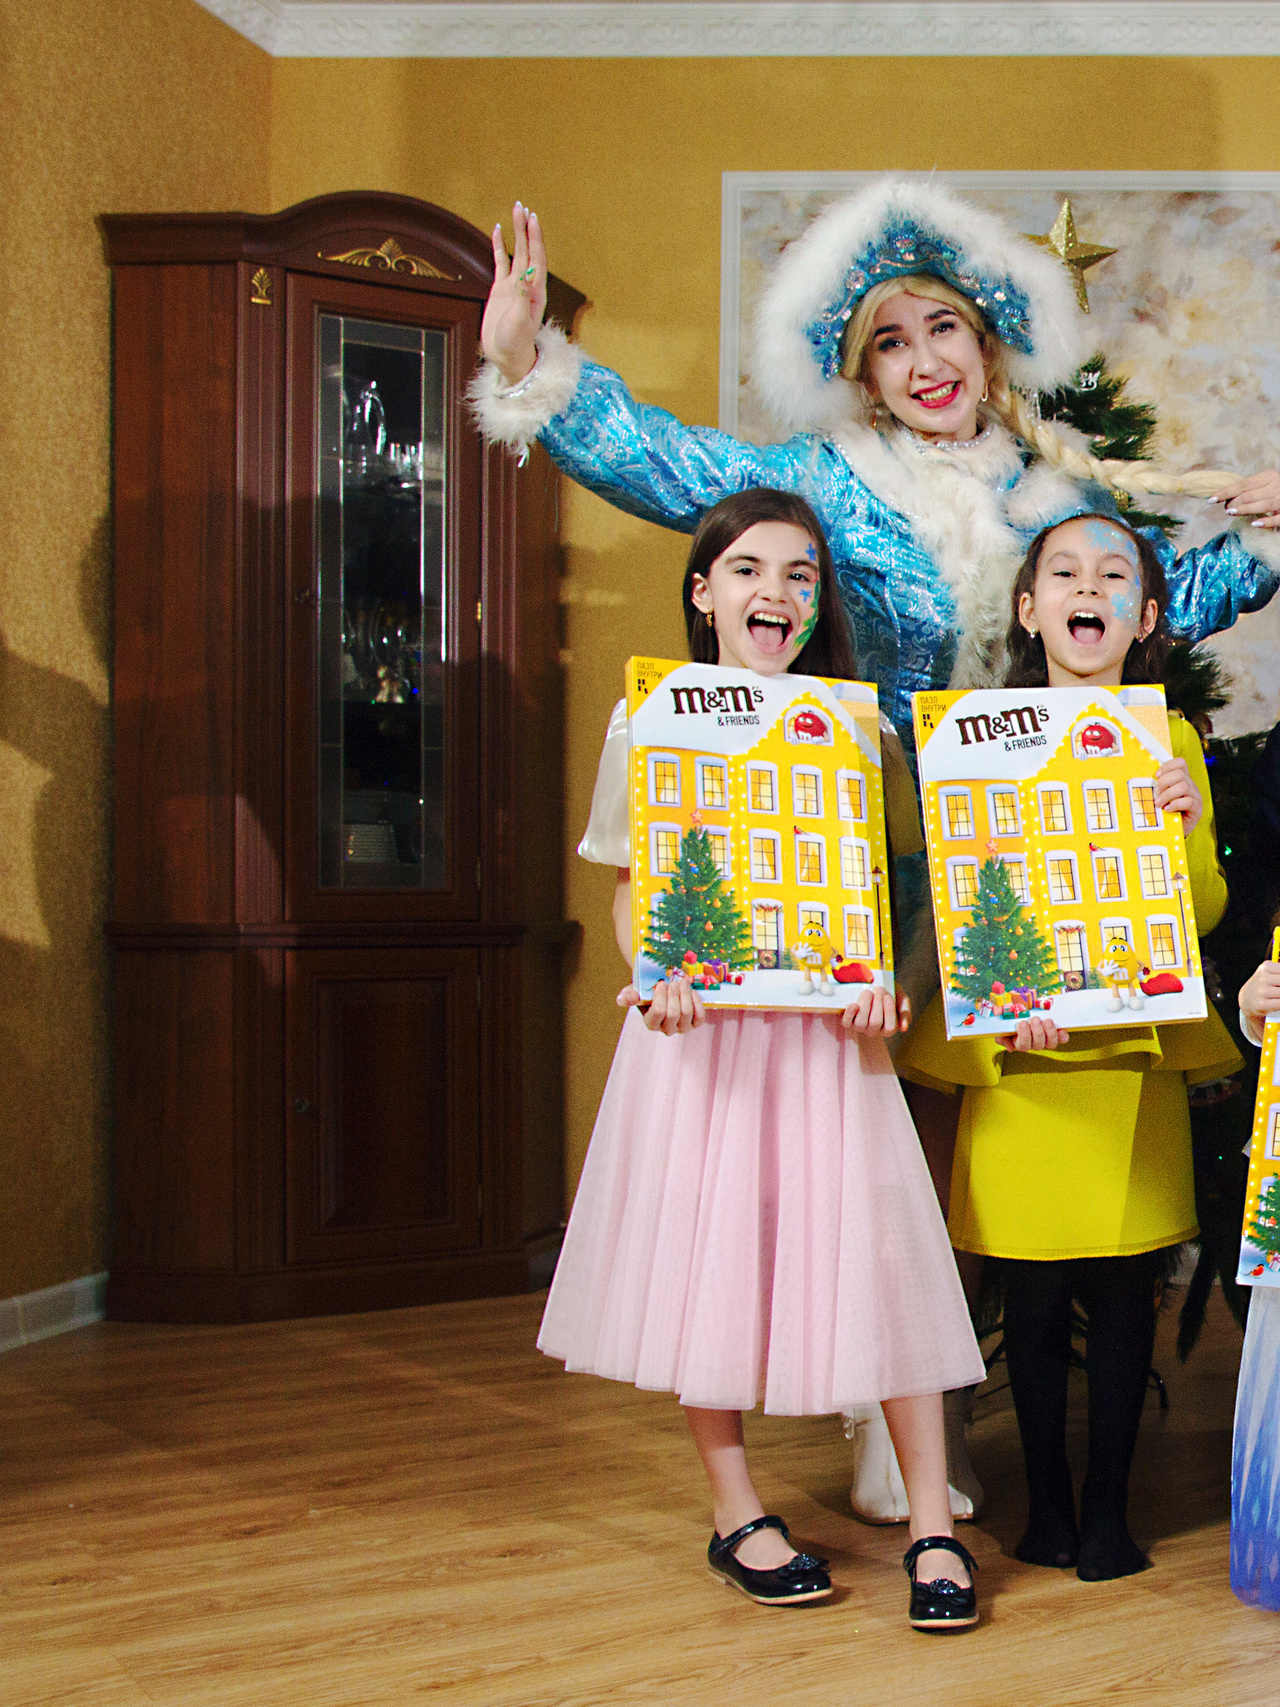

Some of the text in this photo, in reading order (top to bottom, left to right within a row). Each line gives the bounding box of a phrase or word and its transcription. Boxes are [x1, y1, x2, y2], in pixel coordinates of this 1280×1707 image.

[636, 662, 654, 670] ПАЗЛ
[636, 669, 663, 679] ВНУТРИ
[920, 696, 938, 704] ПАЗЛ
[921, 704, 947, 712] ВНУТРИ
[717, 715, 760, 726] & FRIENDS
[1004, 735, 1047, 752] & FRIENDS
